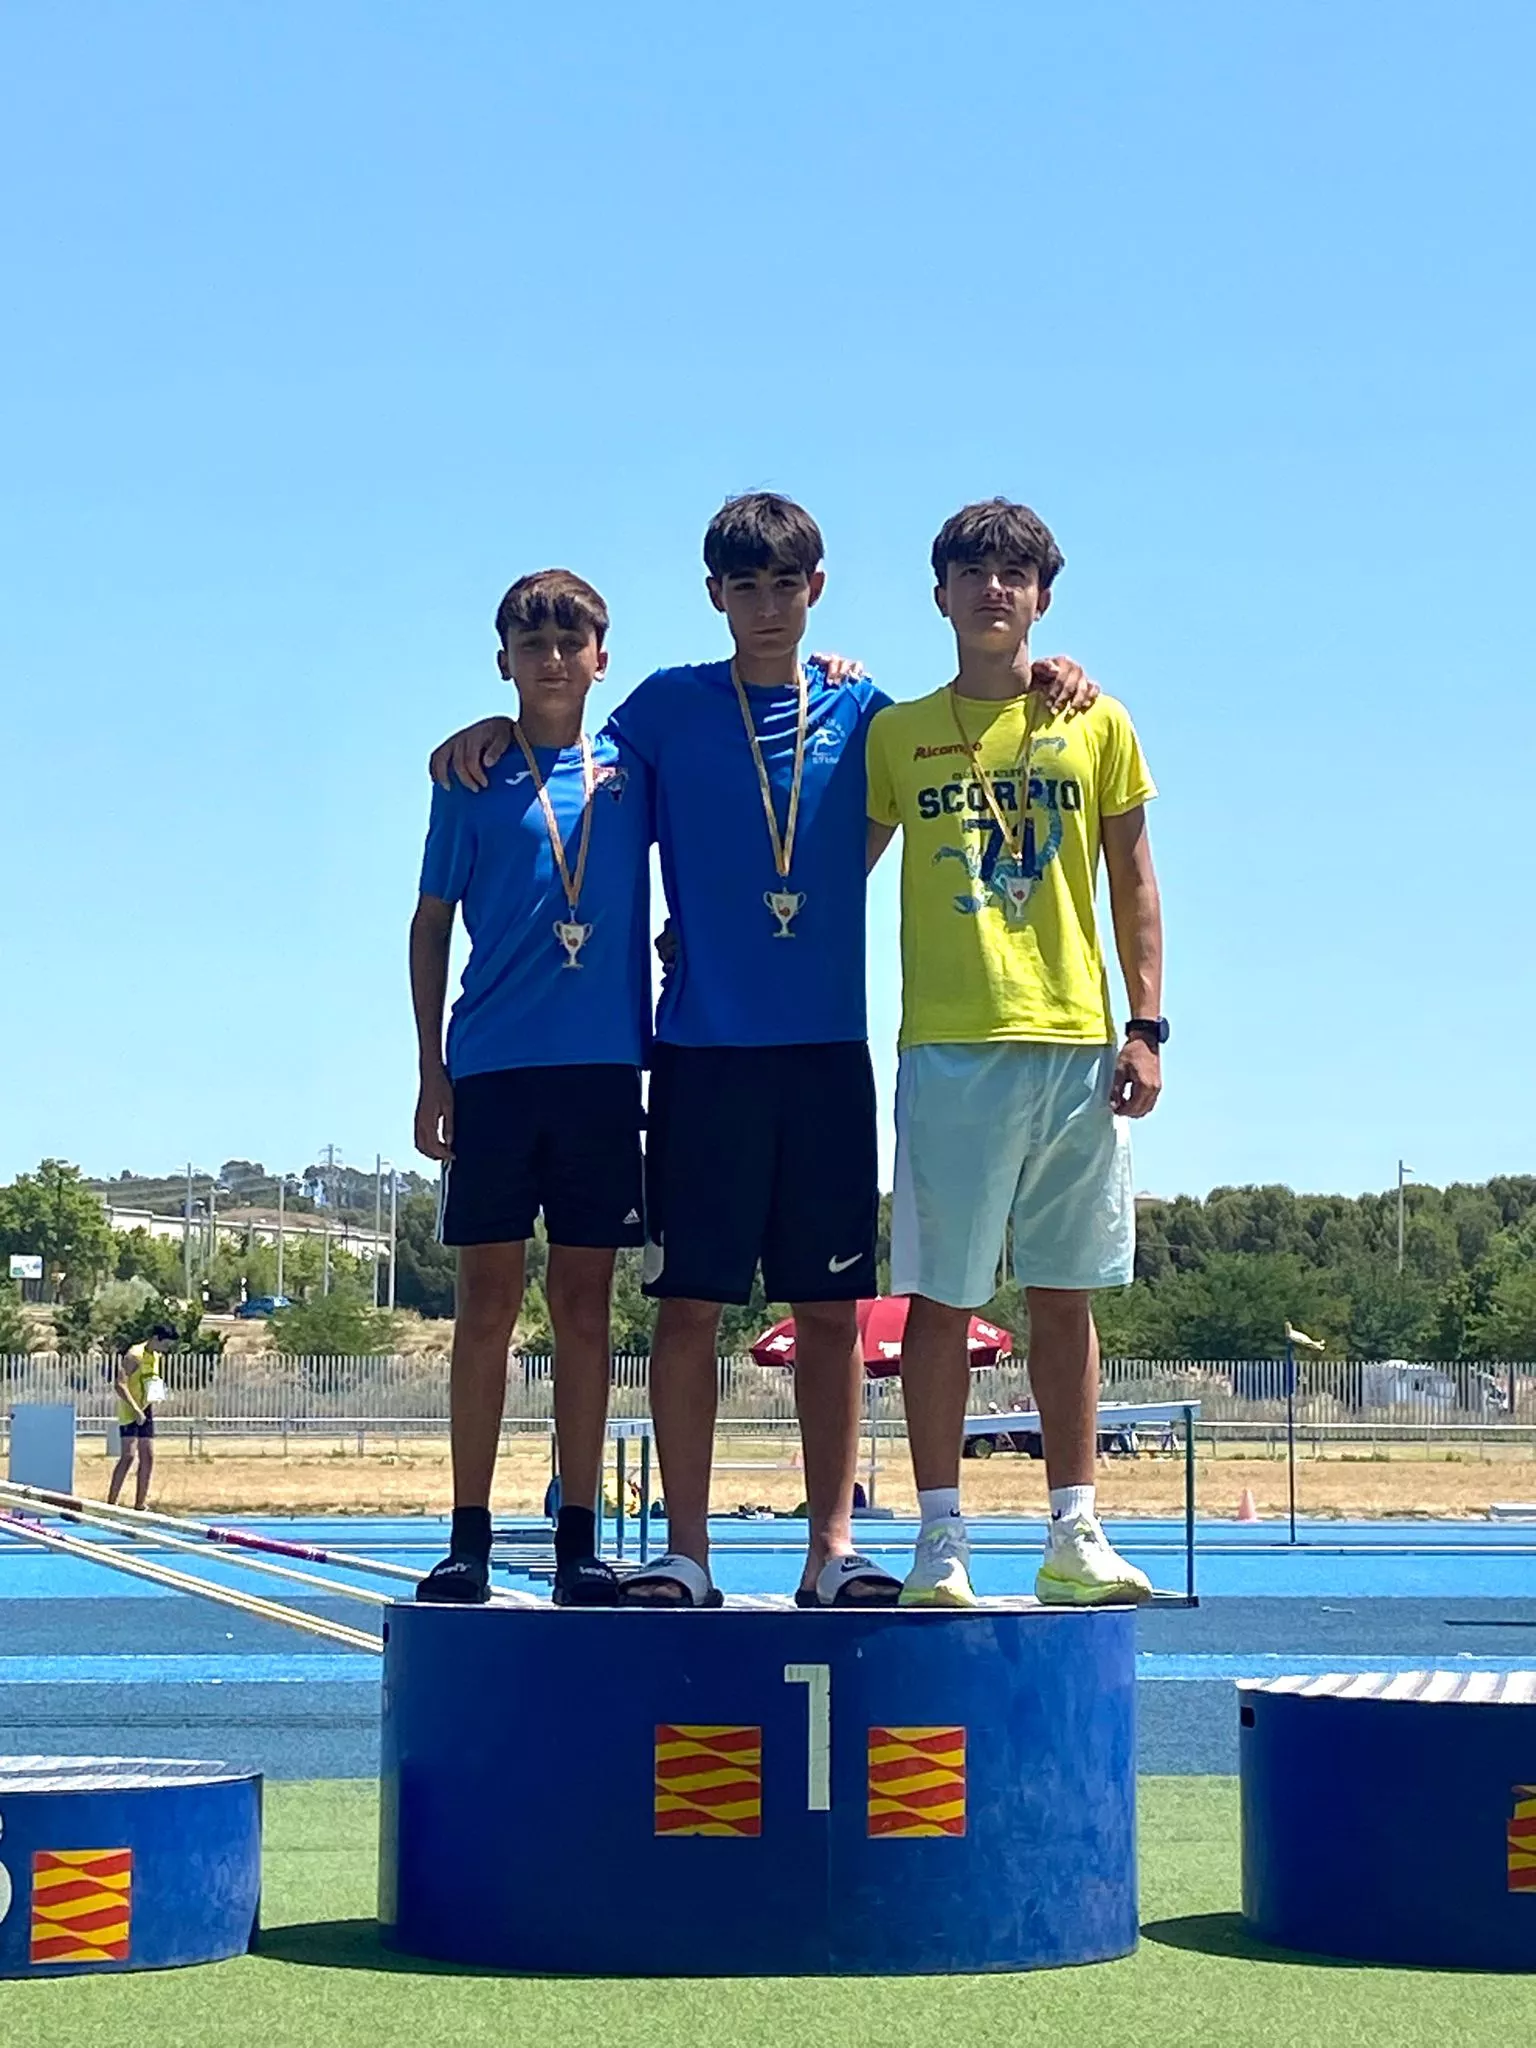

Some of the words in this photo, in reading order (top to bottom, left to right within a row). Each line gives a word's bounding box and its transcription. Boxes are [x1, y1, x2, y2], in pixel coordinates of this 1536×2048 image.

[913, 742, 983, 761] Alcamo
[918, 779, 1080, 819] SCORPIO
[784, 1663, 831, 1811] 1
